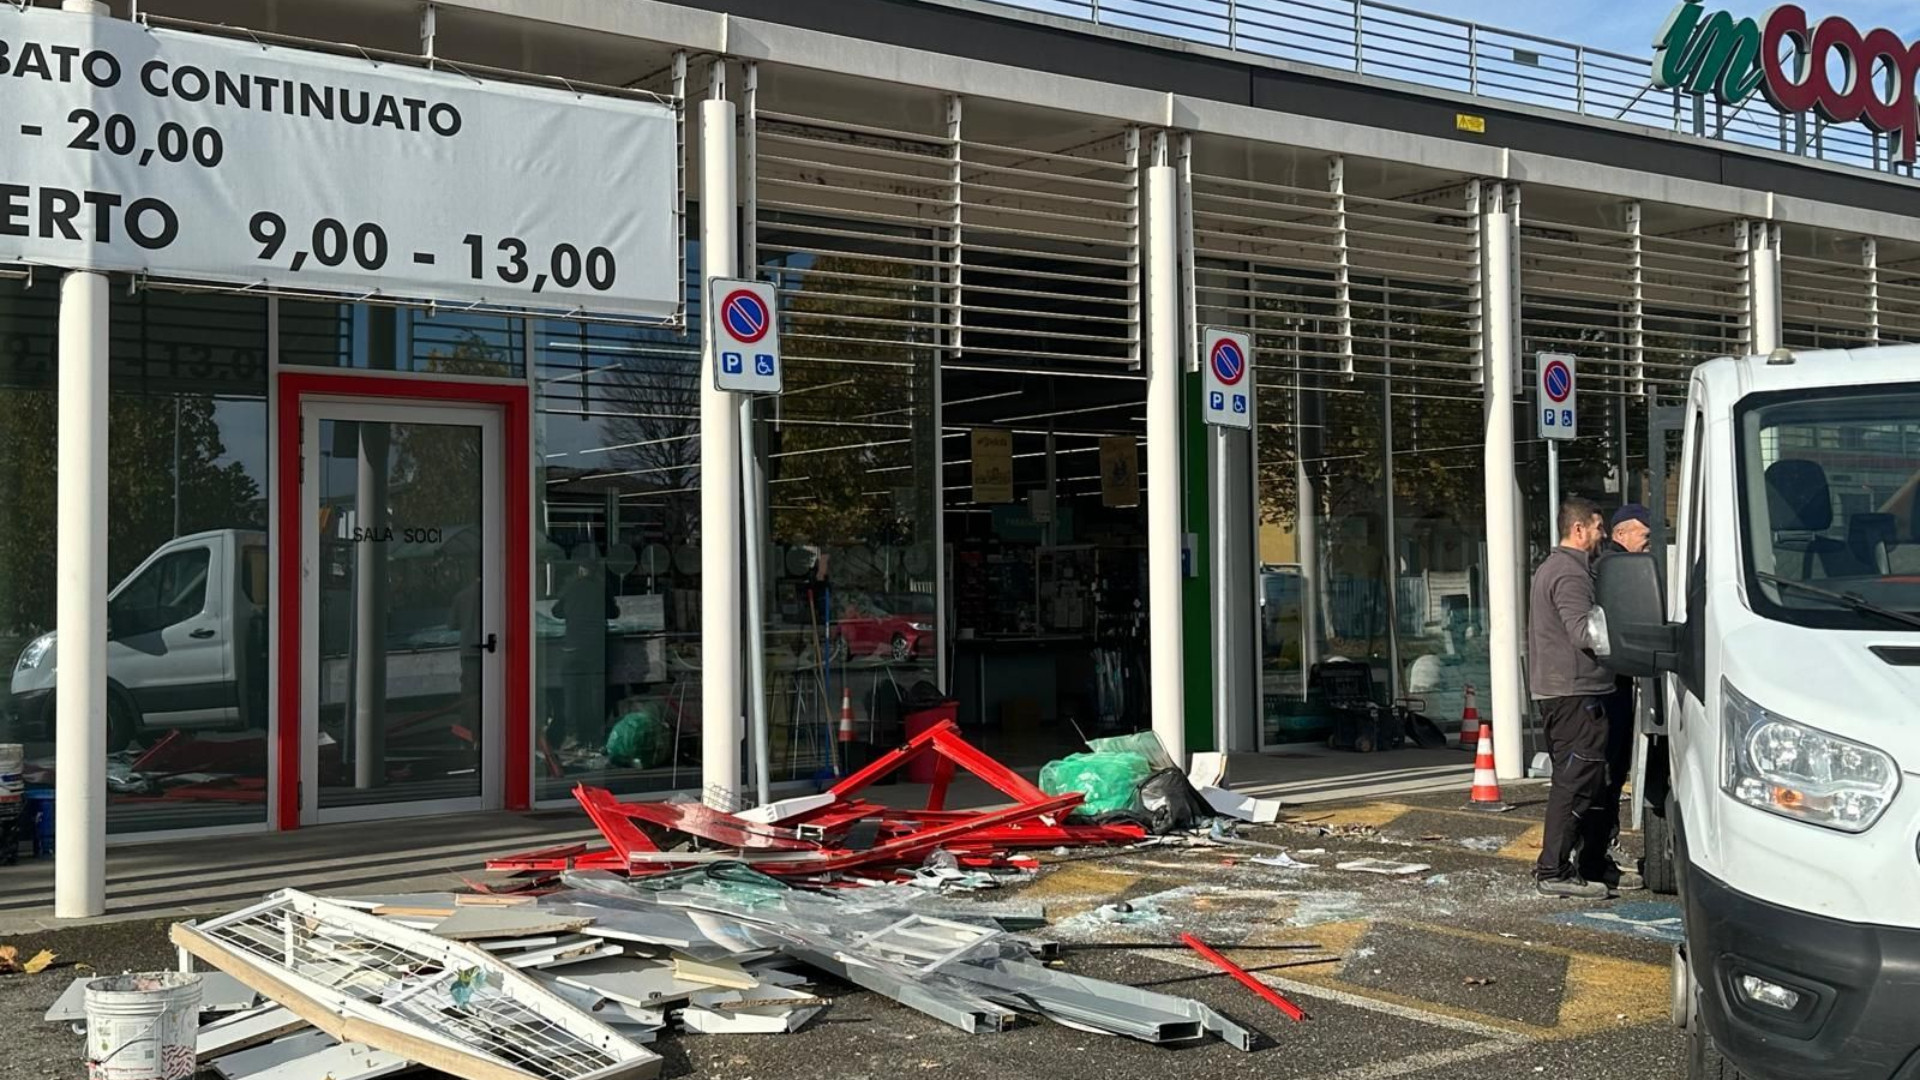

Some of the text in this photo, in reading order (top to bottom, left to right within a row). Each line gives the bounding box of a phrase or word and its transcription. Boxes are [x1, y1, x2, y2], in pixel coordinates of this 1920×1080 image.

[140, 60, 462, 137] CONTINUATO
[67, 108, 224, 168] 20,00
[0, 183, 179, 250] ERTO
[248, 211, 388, 272] 9,00
[462, 233, 616, 294] 13,00
[725, 354, 740, 372] P
[1212, 392, 1223, 409] P
[1545, 409, 1555, 425] P
[353, 526, 443, 544] SALA SOCI
